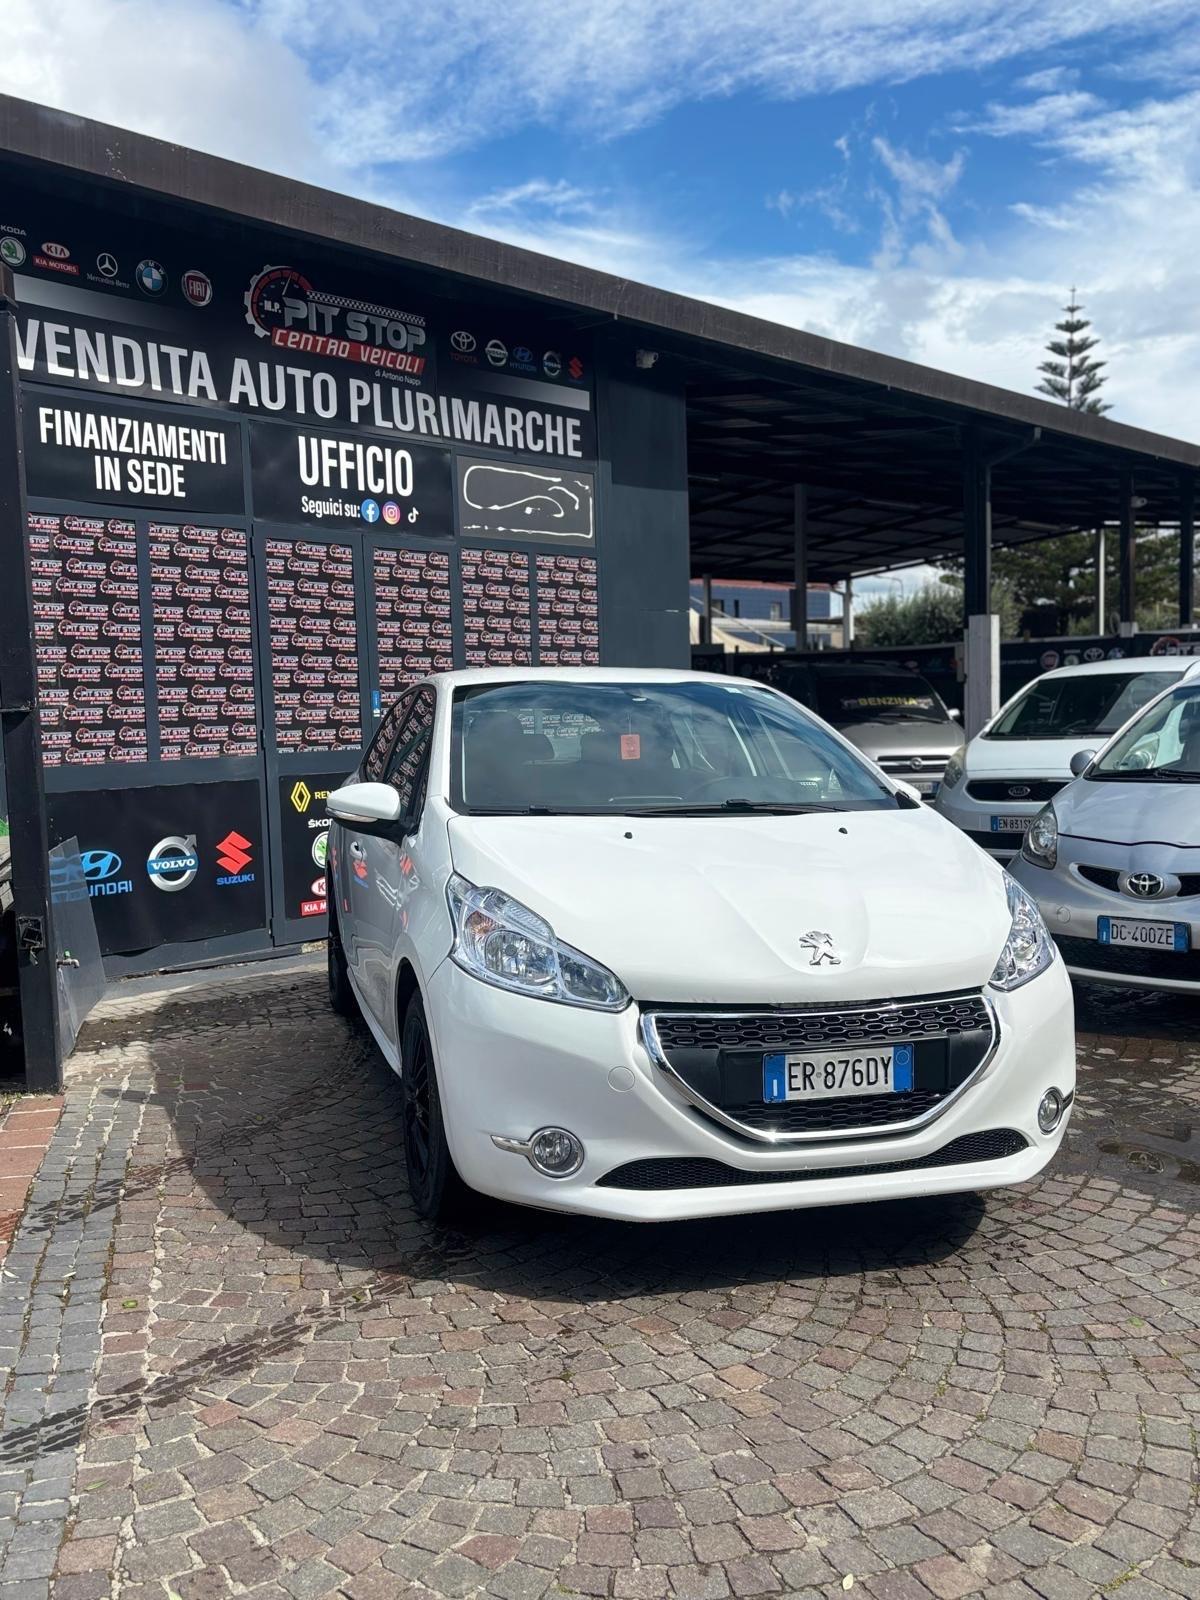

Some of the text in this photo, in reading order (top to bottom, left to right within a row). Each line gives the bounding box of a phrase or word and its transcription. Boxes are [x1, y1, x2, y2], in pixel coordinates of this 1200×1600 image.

[0, 224, 27, 236] KODA
[46, 244, 66, 257] KIA
[35, 258, 77, 273] KIA MOTORS
[188, 280, 205, 297] FIAT
[282, 297, 426, 353] PIT STOP
[382, 370, 404, 382] Antonio
[16, 319, 582, 458] VENDITA AUTO PLURIMARCHE
[39, 407, 226, 465] FINANZIAMENTI
[298, 436, 414, 497] UFFICIO
[95, 455, 186, 497] IN SEDE
[301, 496, 360, 520] Seguici su:
[858, 697, 917, 706] BENZINA
[308, 818, 333, 828] ŠKO
[999, 819, 1008, 829] EN
[151, 858, 195, 871] VOLVO
[216, 873, 255, 886] SUZUKI
[304, 904, 318, 912] KIA
[1111, 924, 1174, 946] DC 400ZE
[788, 1056, 892, 1092] ER 876DY
[773, 1079, 777, 1096] I
